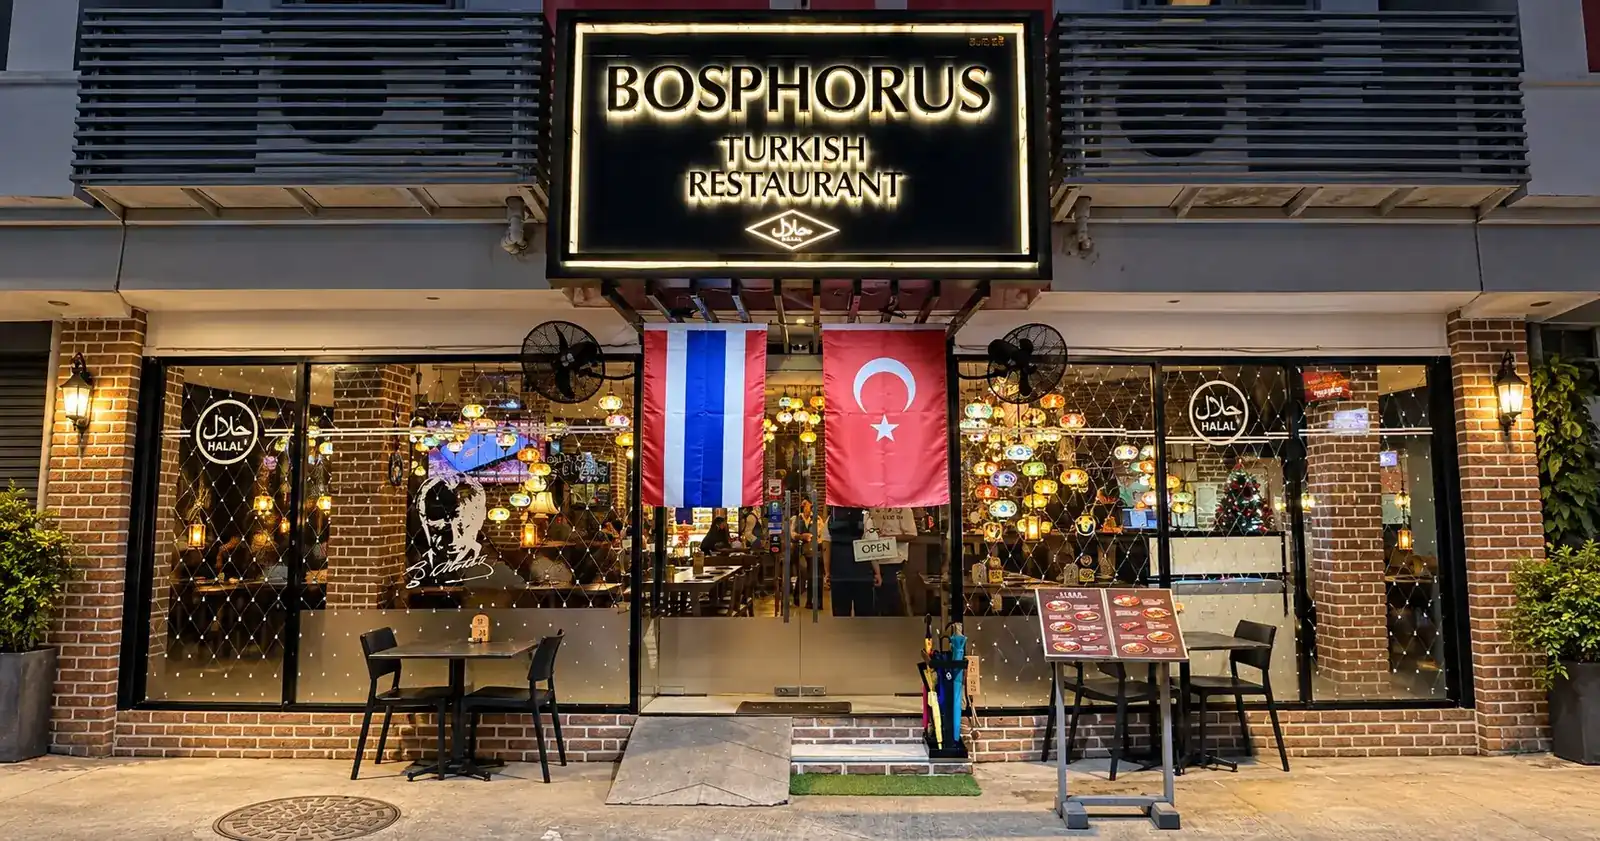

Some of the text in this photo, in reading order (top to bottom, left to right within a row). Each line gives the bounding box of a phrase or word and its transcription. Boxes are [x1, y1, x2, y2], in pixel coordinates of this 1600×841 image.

[607, 64, 992, 114] BOSPHORUS
[722, 135, 866, 163] TURKISH
[688, 170, 904, 199] RESTAURANT
[1195, 394, 1244, 421] حلال
[202, 414, 253, 440] حلال
[1201, 421, 1236, 432] HALAL
[207, 441, 244, 452] HALAL
[861, 543, 891, 554] OPEN
